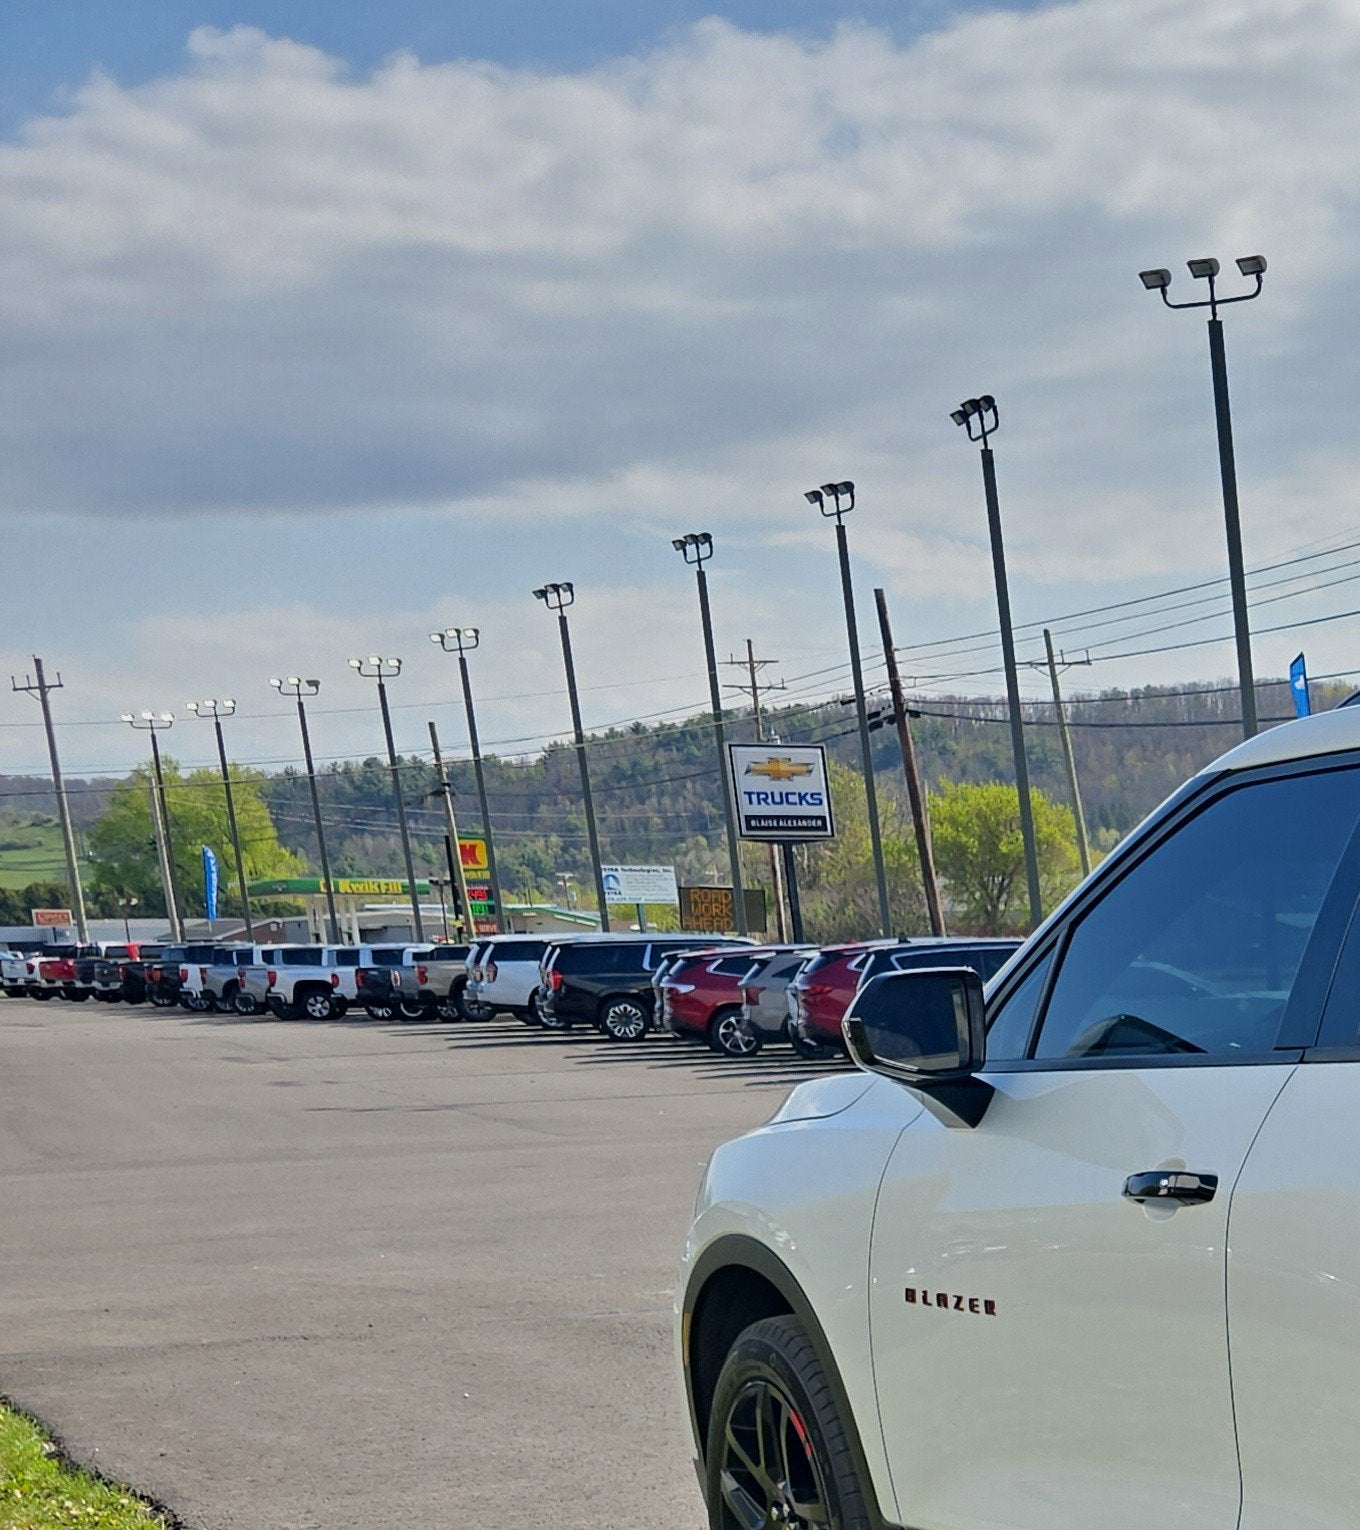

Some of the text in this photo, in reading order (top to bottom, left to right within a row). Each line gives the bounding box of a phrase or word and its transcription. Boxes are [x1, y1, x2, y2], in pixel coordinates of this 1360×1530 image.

[743, 791, 823, 806] TRUCKS
[751, 819, 822, 827] BLAISE ALEXANDER
[339, 880, 403, 894] Kwik Fill
[690, 889, 732, 903] ROAD
[691, 903, 733, 917] WORK
[683, 916, 734, 931] AHEAD
[904, 1287, 997, 1316] BLAZER
